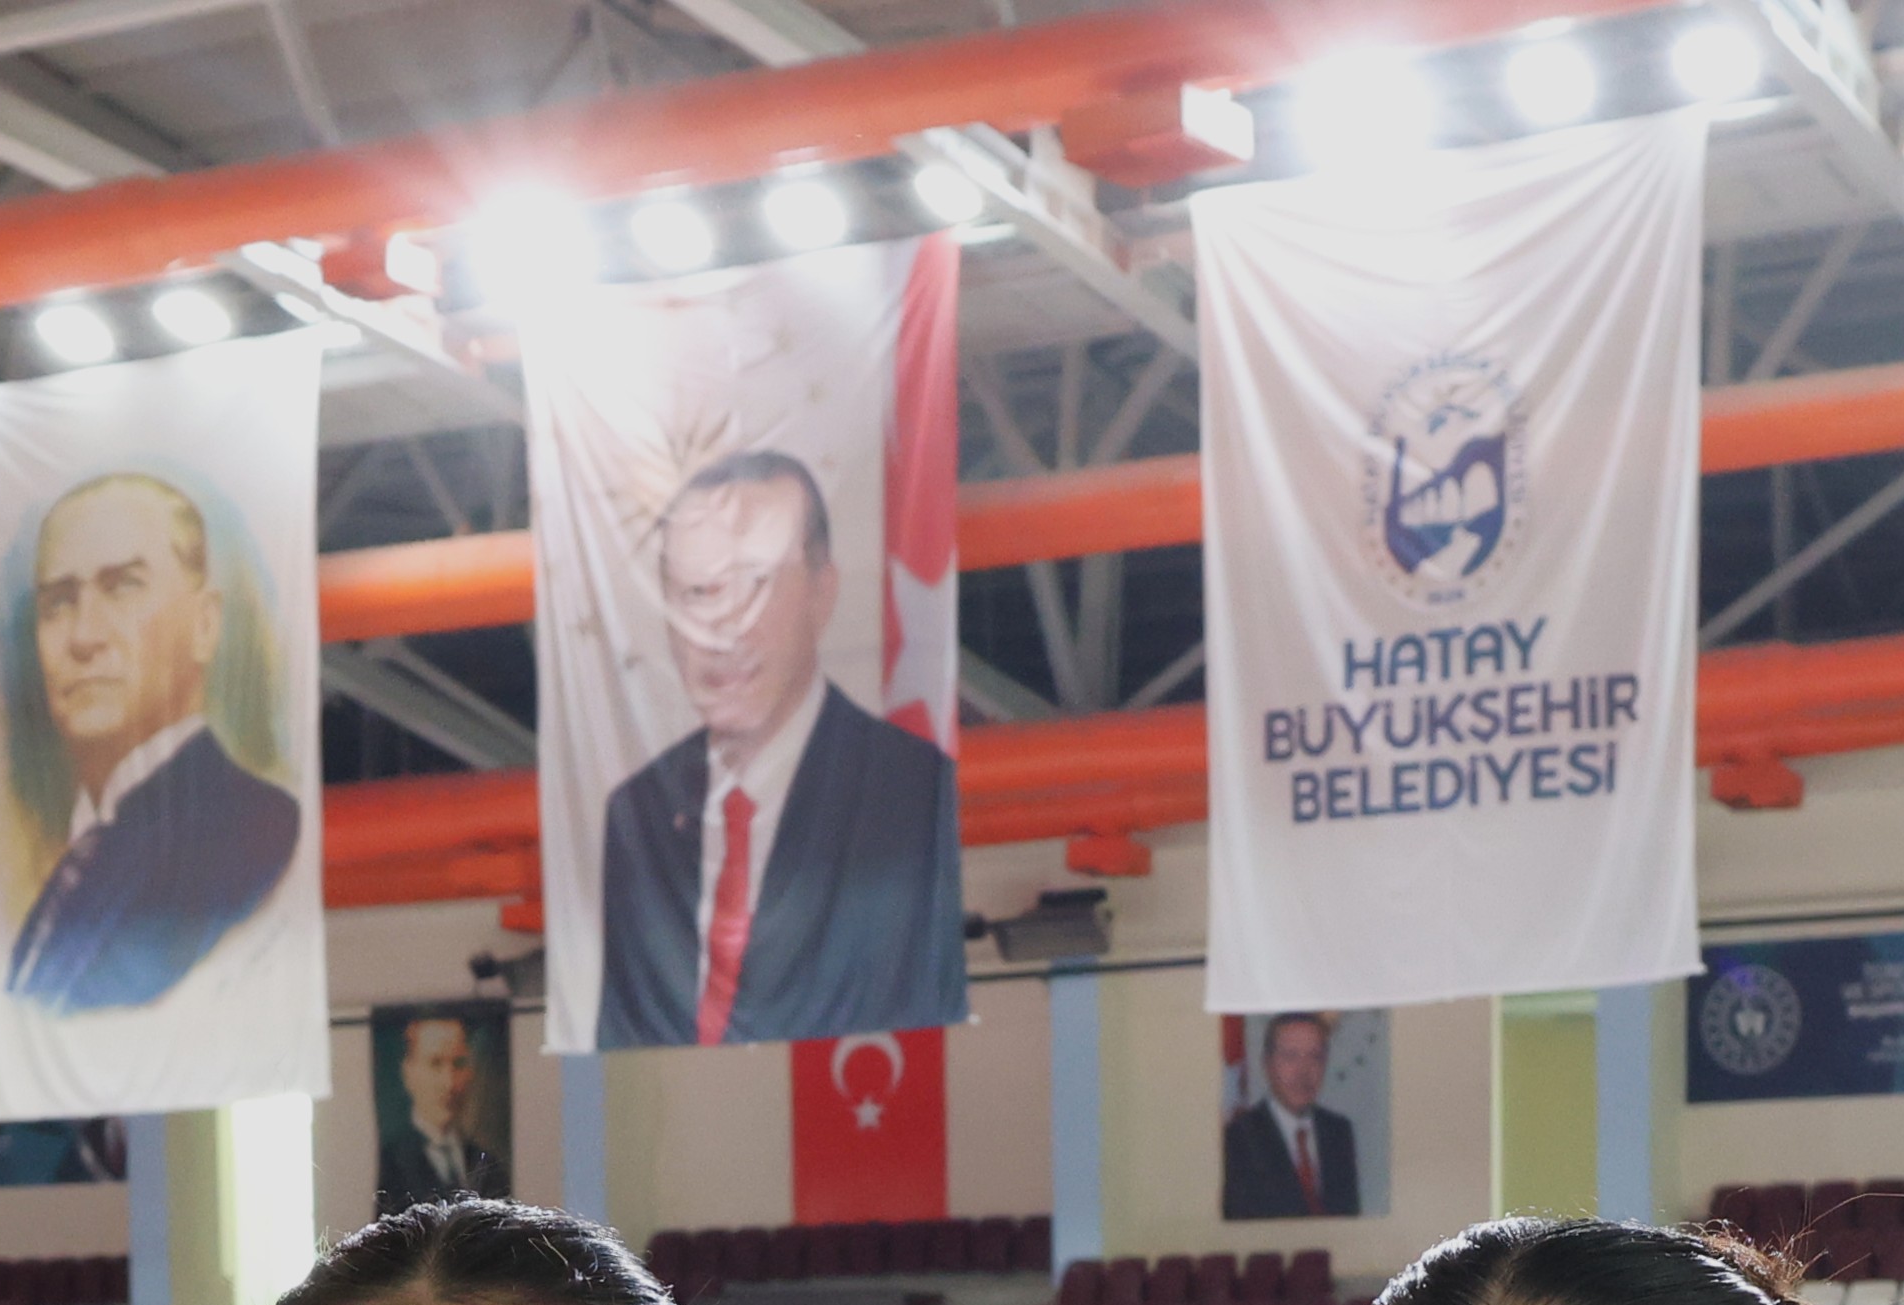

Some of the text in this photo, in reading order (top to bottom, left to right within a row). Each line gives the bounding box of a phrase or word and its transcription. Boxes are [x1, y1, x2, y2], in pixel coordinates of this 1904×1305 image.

[1343, 615, 1547, 690] HATAY
[1264, 672, 1639, 764] BÜYÜKŞEHİR
[1291, 741, 1617, 824] BELEDİYESİ
